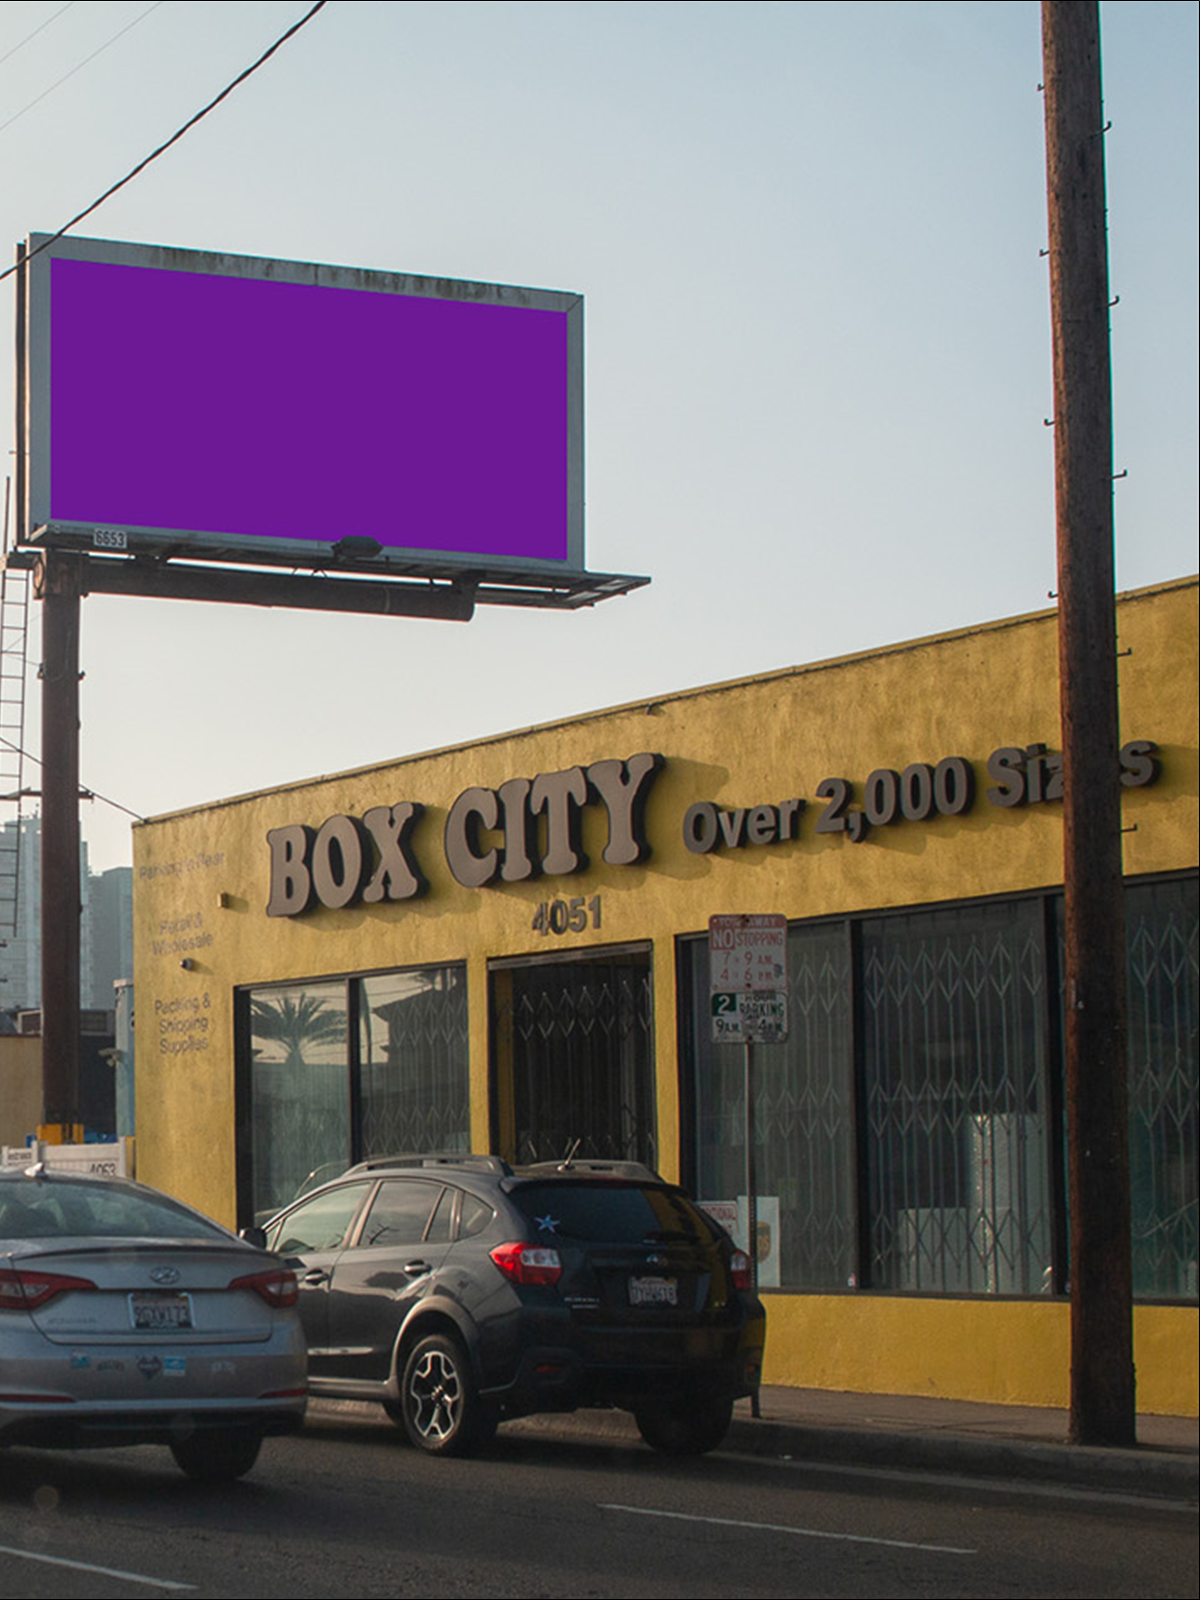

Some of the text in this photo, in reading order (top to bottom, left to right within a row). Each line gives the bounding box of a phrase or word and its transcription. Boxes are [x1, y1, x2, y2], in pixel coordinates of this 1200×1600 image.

[96, 529, 124, 546] 6653
[682, 740, 1160, 853] Over 2,000 Sizs
[266, 753, 665, 918] BOX CITY
[532, 894, 601, 936] 4051
[712, 929, 784, 949] NO STOPPING
[744, 951, 753, 965] 9
[720, 968, 729, 981] 4
[744, 968, 753, 981] 6
[717, 994, 731, 1015] 2
